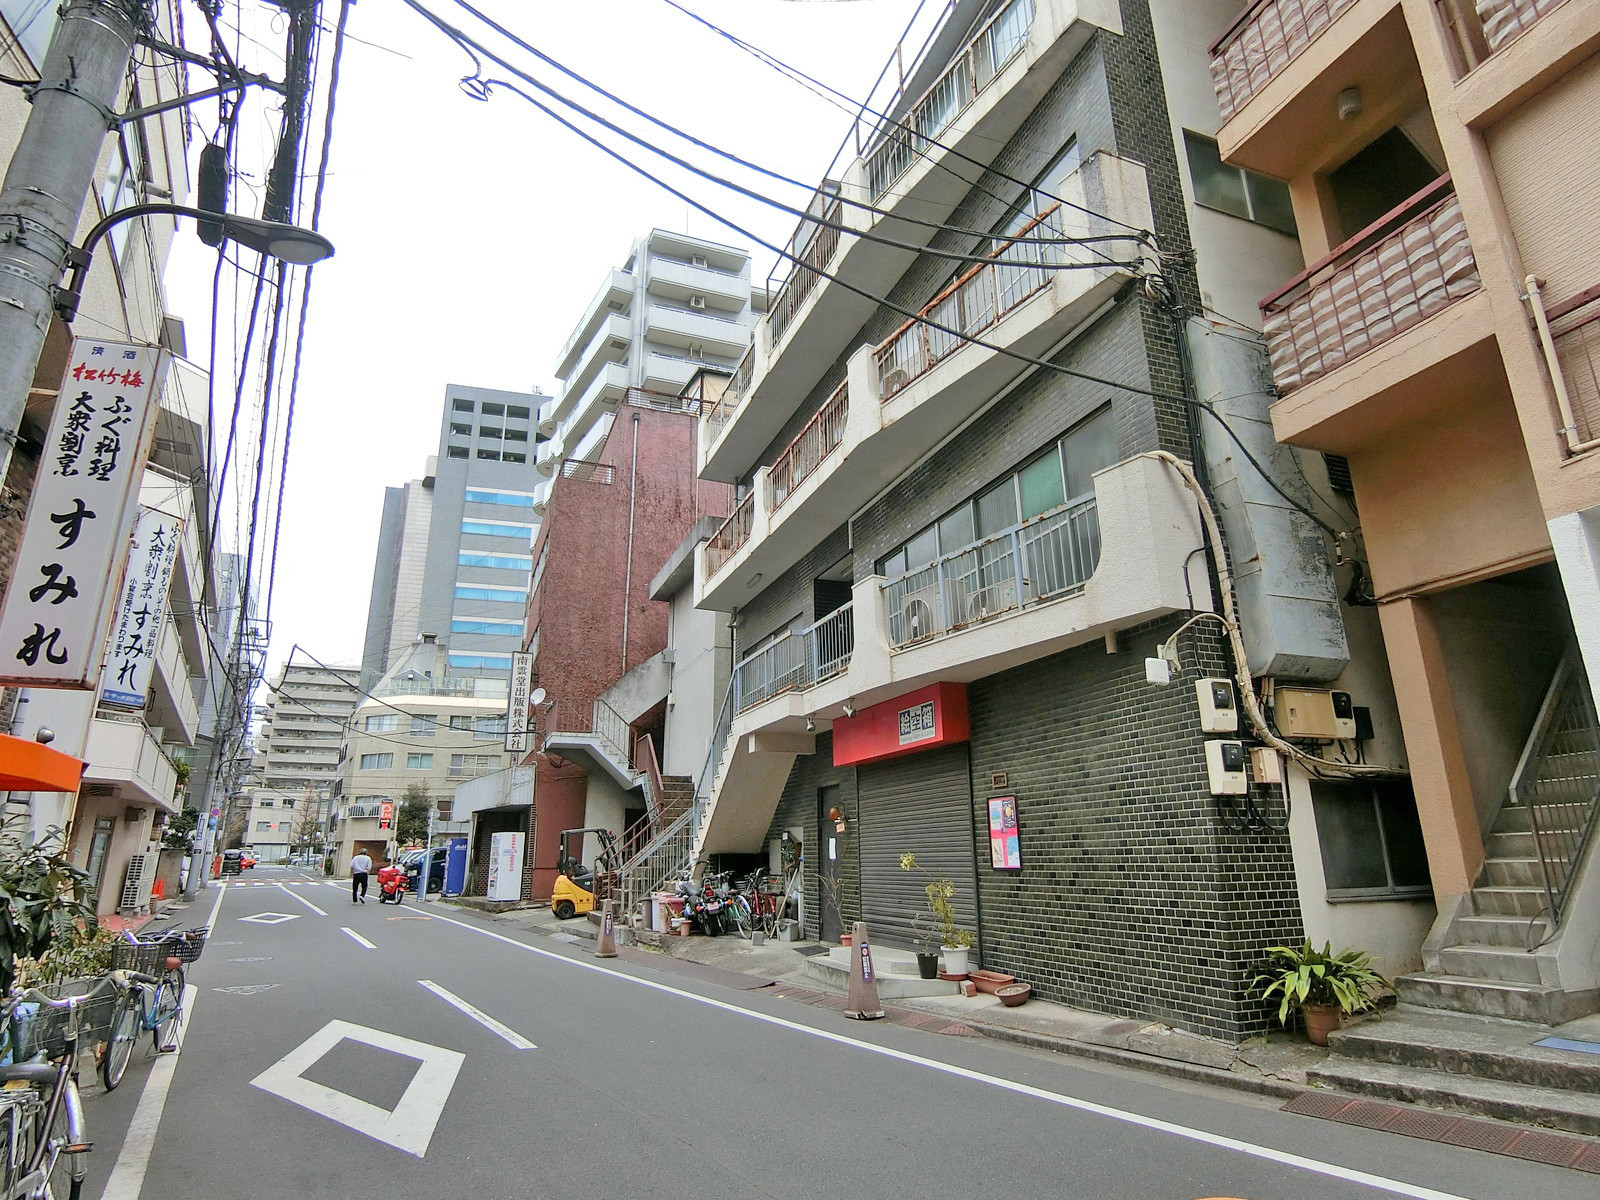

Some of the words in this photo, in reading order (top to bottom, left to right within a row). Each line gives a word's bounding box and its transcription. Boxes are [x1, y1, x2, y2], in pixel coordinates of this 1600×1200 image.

[72, 362, 145, 388] 松竹梅
[91, 346, 137, 360] 清酒
[54, 391, 97, 477] 大衆割烹
[87, 395, 132, 482] ふぐ料理
[16, 498, 96, 667] すみれ
[140, 523, 166, 600] 大衆割烹
[117, 602, 152, 691] すみれ
[511, 655, 528, 750] 南雲堂出版株式会社
[901, 705, 933, 734] 絵空箱
